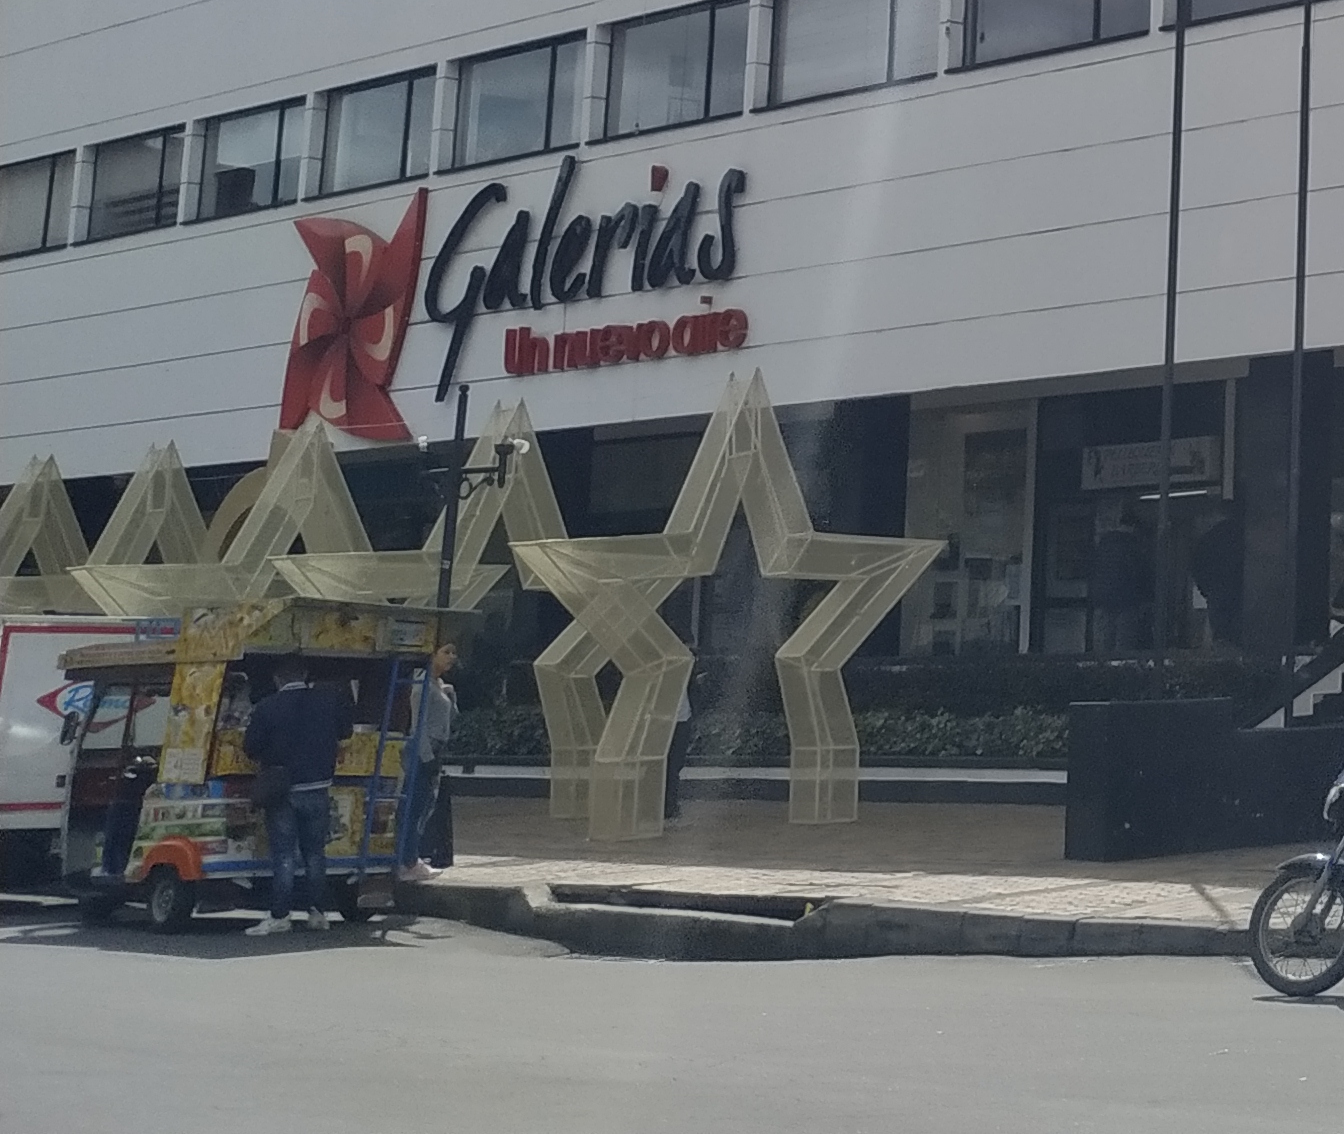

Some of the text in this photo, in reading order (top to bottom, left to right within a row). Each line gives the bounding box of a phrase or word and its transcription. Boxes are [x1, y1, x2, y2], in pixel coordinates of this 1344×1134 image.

[504, 295, 748, 375] Un nuevo aire
